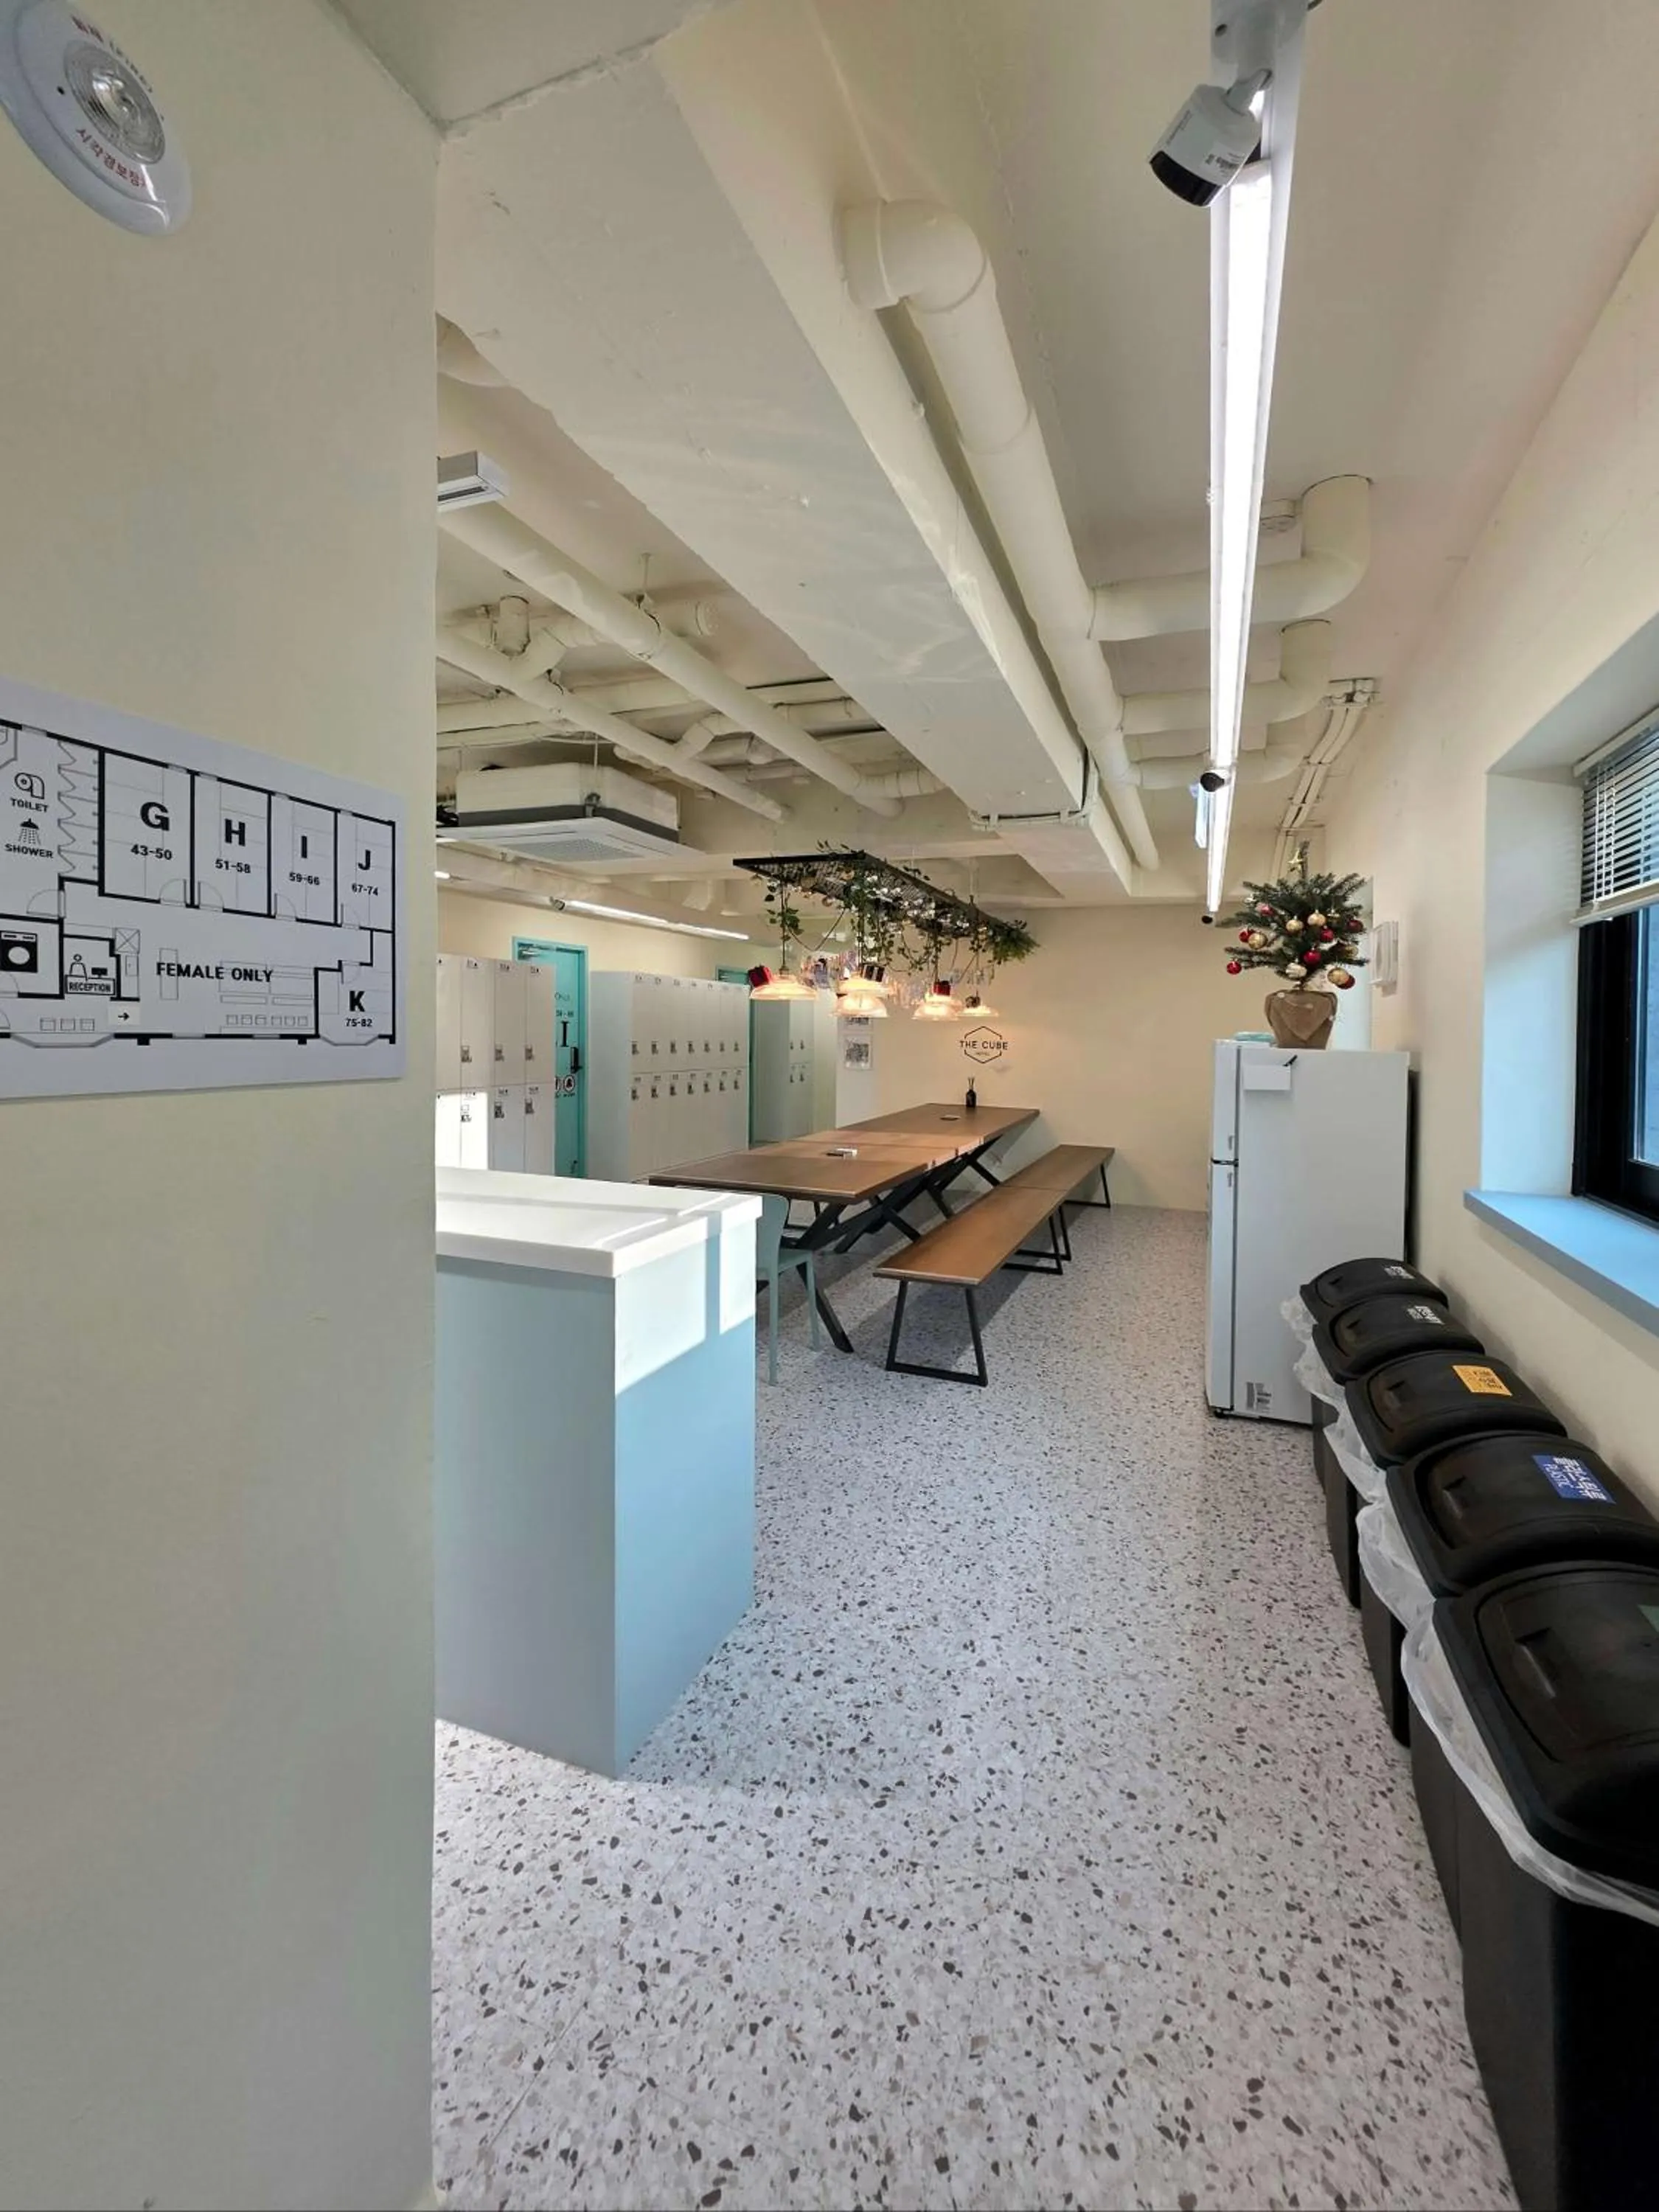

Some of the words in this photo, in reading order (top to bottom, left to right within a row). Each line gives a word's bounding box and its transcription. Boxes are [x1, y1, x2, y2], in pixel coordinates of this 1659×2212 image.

[10, 797, 49, 813] TOILET
[140, 801, 170, 831] G
[225, 818, 246, 846] H
[4, 843, 54, 859] SHOWER
[131, 844, 173, 860] 43-50
[301, 835, 307, 859] I
[215, 858, 251, 874] 51-58
[358, 849, 371, 871] J
[289, 872, 320, 886] 59-66
[351, 883, 379, 897] 67-74
[156, 962, 225, 980] FEMALE
[232, 967, 274, 983] ONLY
[69, 982, 111, 992] RECEPTION
[349, 990, 365, 1012] K
[346, 1018, 373, 1028] 75-82
[959, 1040, 978, 1049] THE
[981, 1040, 1008, 1051] CUBE
